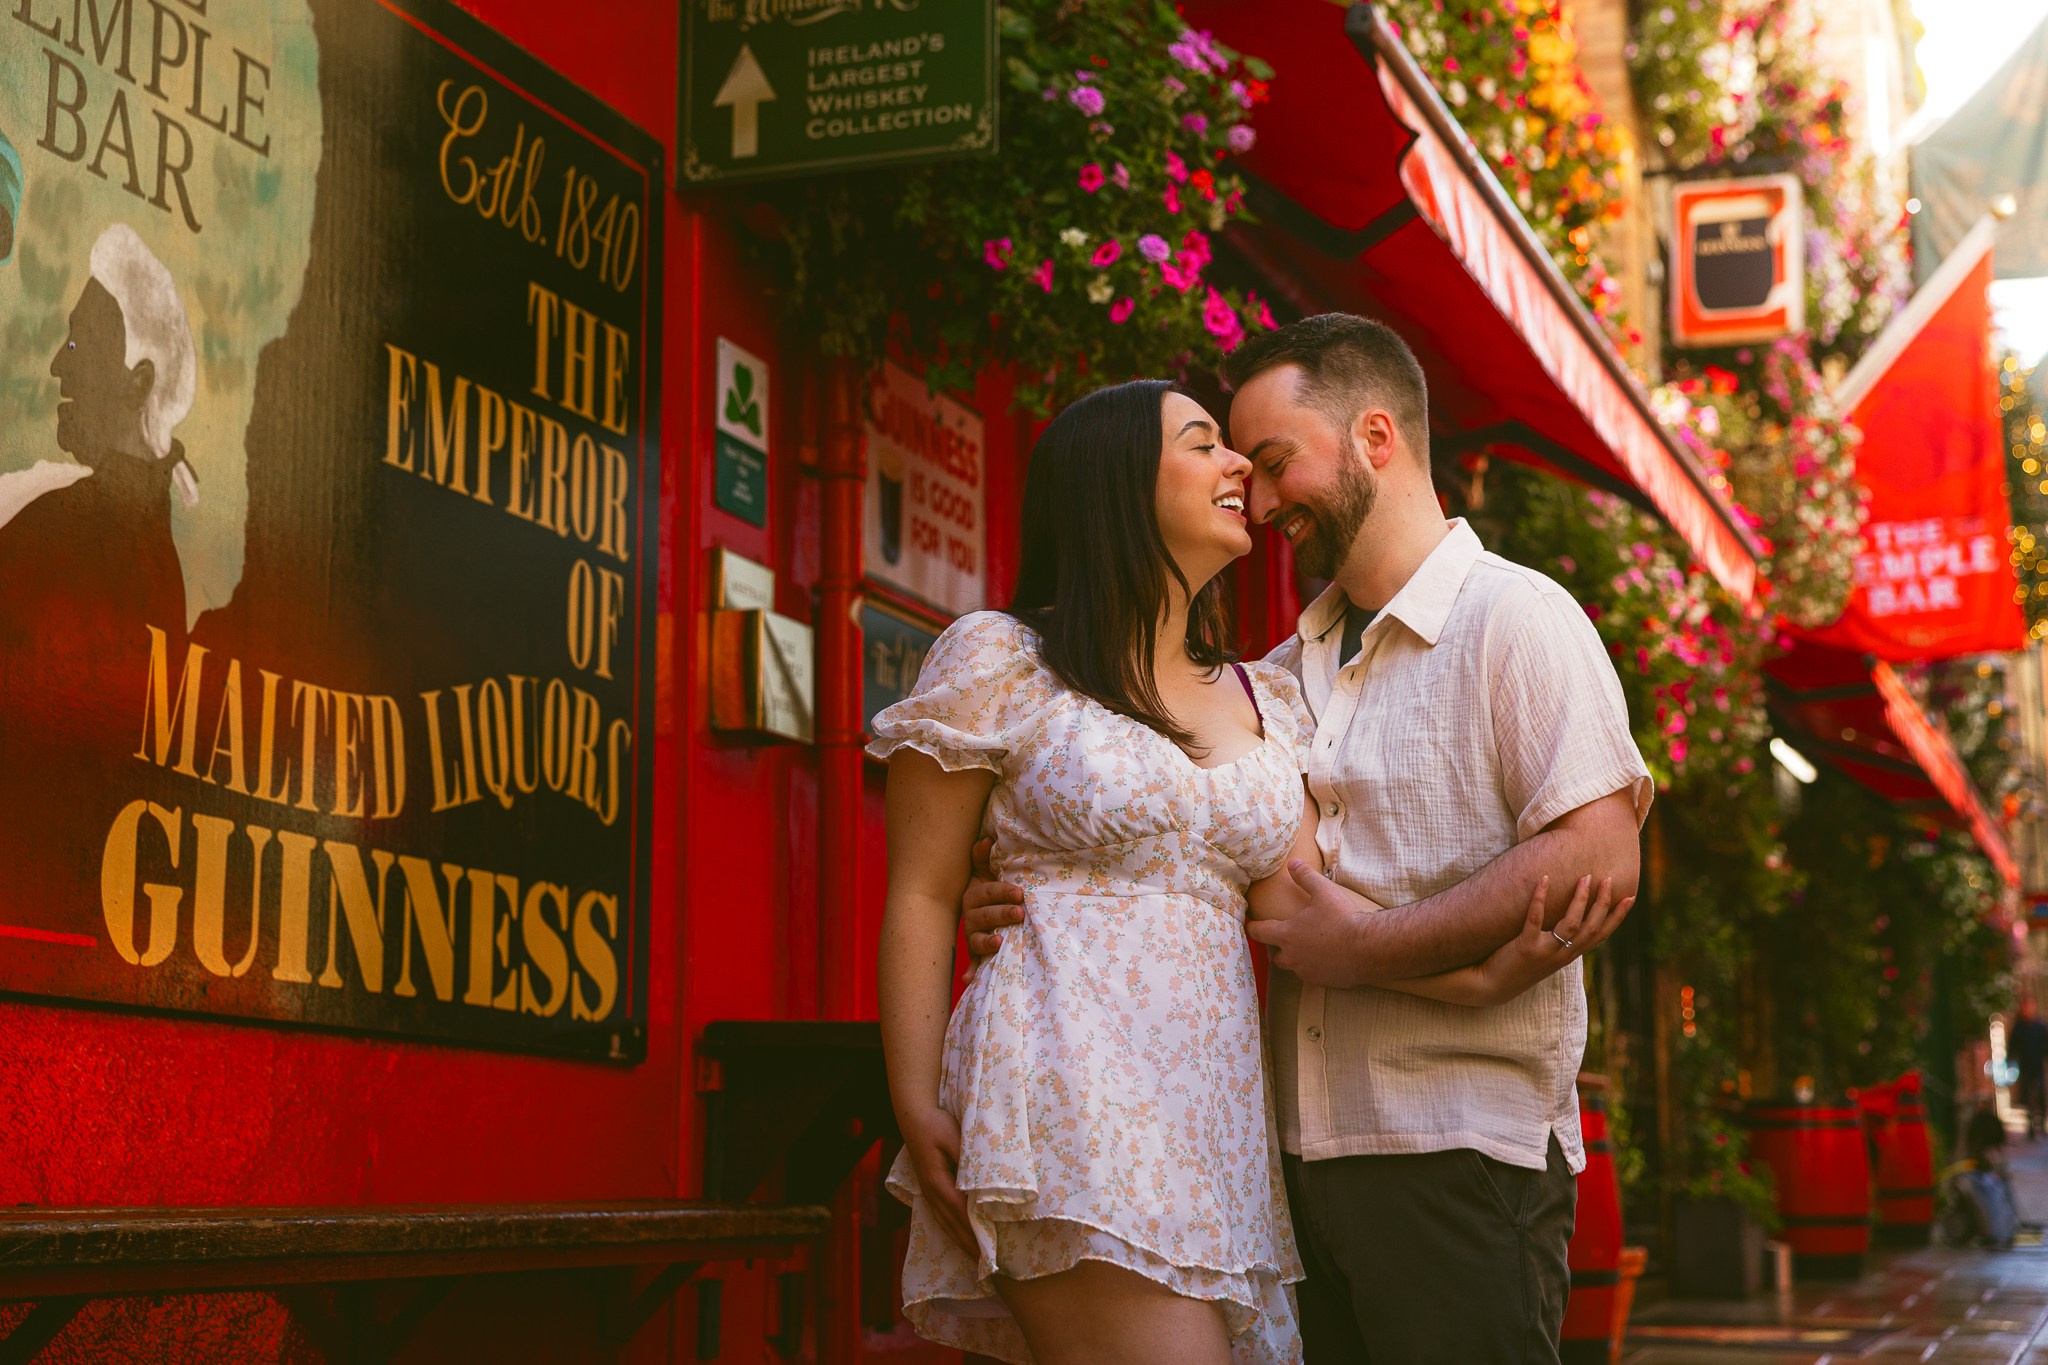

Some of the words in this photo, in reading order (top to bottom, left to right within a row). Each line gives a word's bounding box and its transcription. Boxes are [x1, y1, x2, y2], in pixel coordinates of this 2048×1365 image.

[807, 60, 924, 91] LARGEST
[808, 33, 945, 67] IRELAND'S
[806, 103, 972, 140] COLLECTION
[807, 84, 928, 115] WHISKEY
[36, 47, 202, 234] BAR
[556, 166, 639, 292] 1840
[528, 280, 629, 436] THE
[382, 341, 630, 563] EMPEROR
[910, 468, 926, 505] IS
[929, 480, 975, 531] GOOD
[910, 515, 941, 558] FOR
[946, 533, 977, 576] YOU
[1853, 536, 1999, 586] EMPLE
[1873, 519, 1944, 550] THE
[567, 558, 625, 681] OF
[1869, 577, 1961, 617] BAR
[133, 623, 406, 820] MALTED
[420, 673, 632, 826] LIQUORS
[101, 799, 619, 1022] GUINNESS
